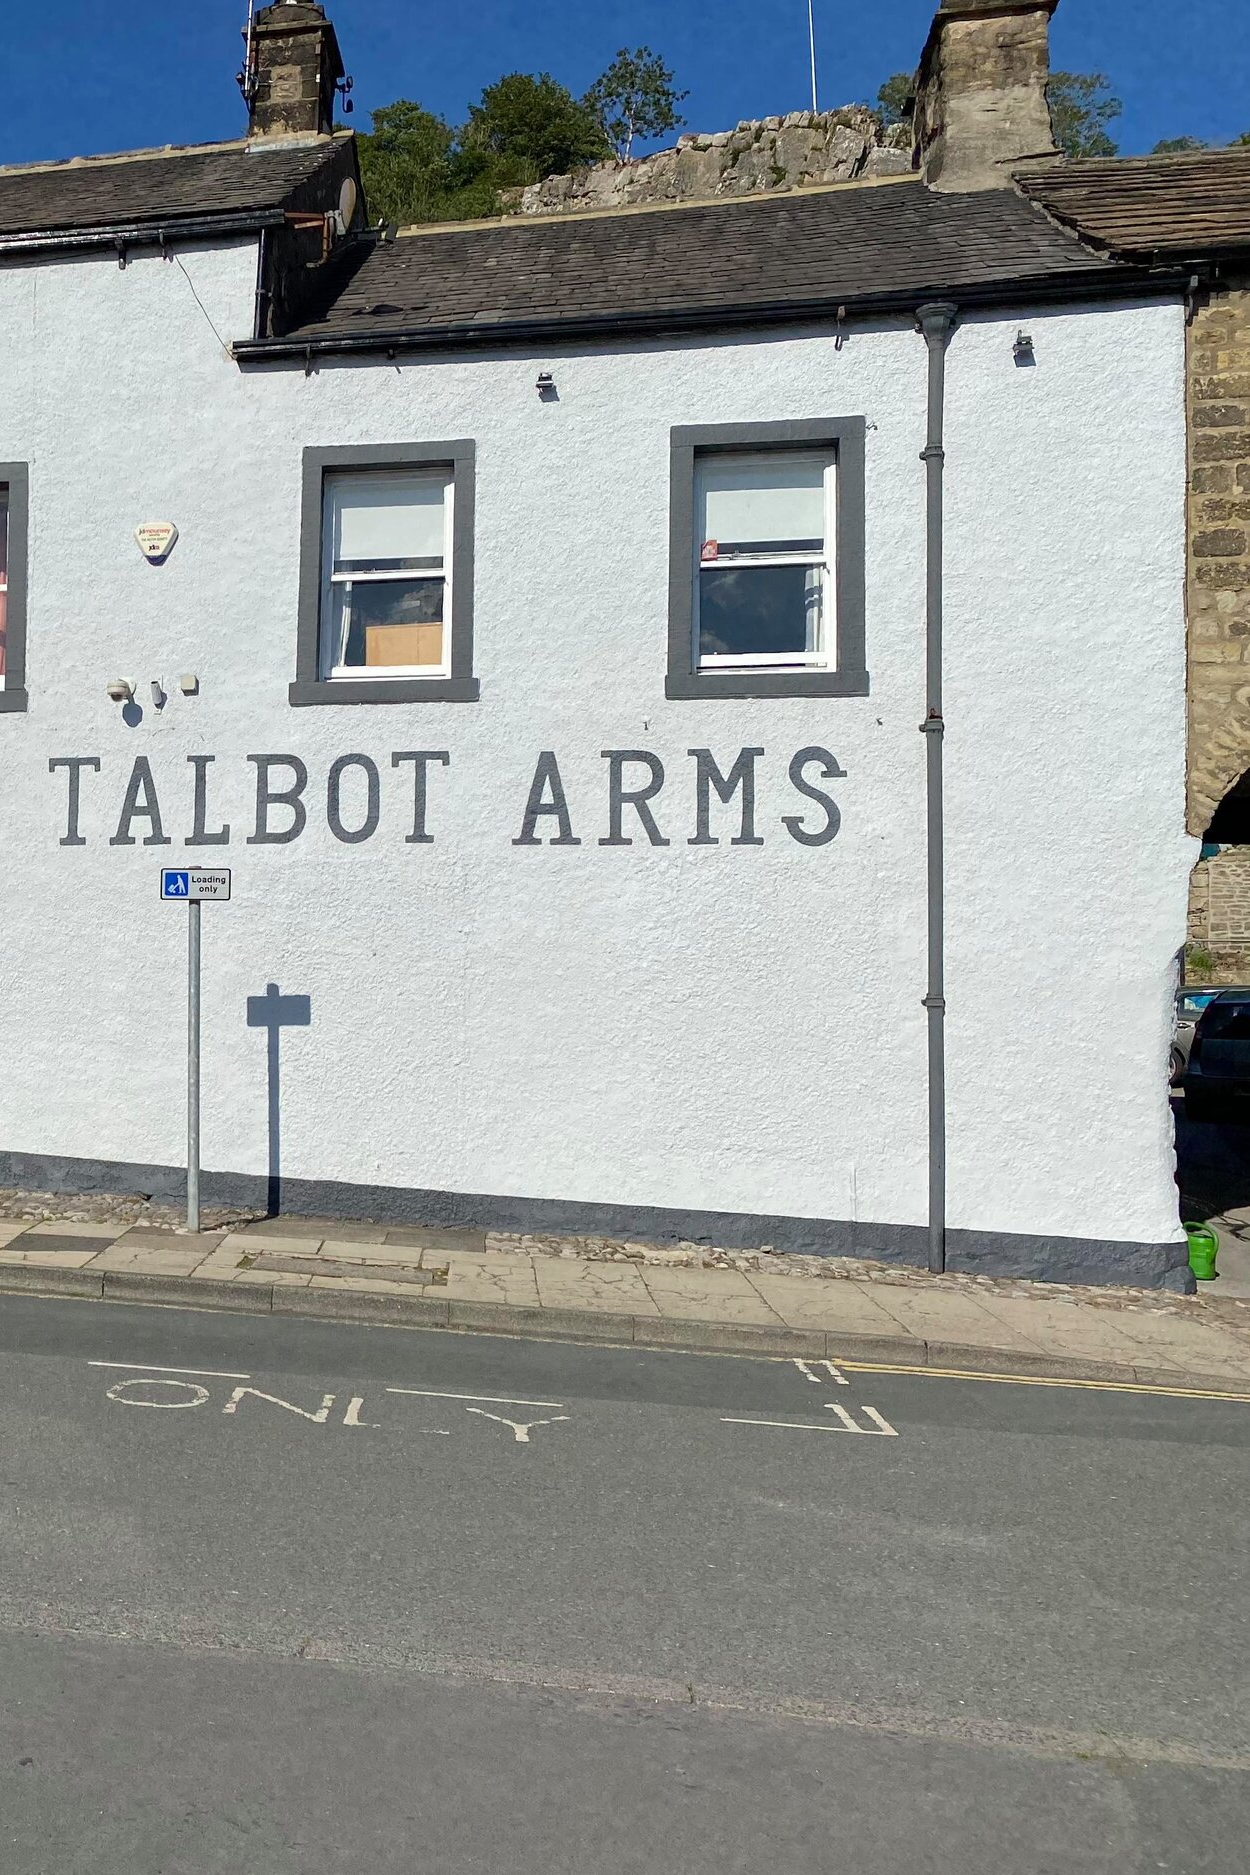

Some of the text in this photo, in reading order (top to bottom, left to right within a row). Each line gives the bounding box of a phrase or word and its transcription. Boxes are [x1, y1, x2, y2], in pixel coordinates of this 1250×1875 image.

[47, 745, 849, 848] TALBOT ARMS
[191, 876, 226, 885] Loading
[199, 885, 218, 894] only
[105, 1378, 572, 1443] ONLY
